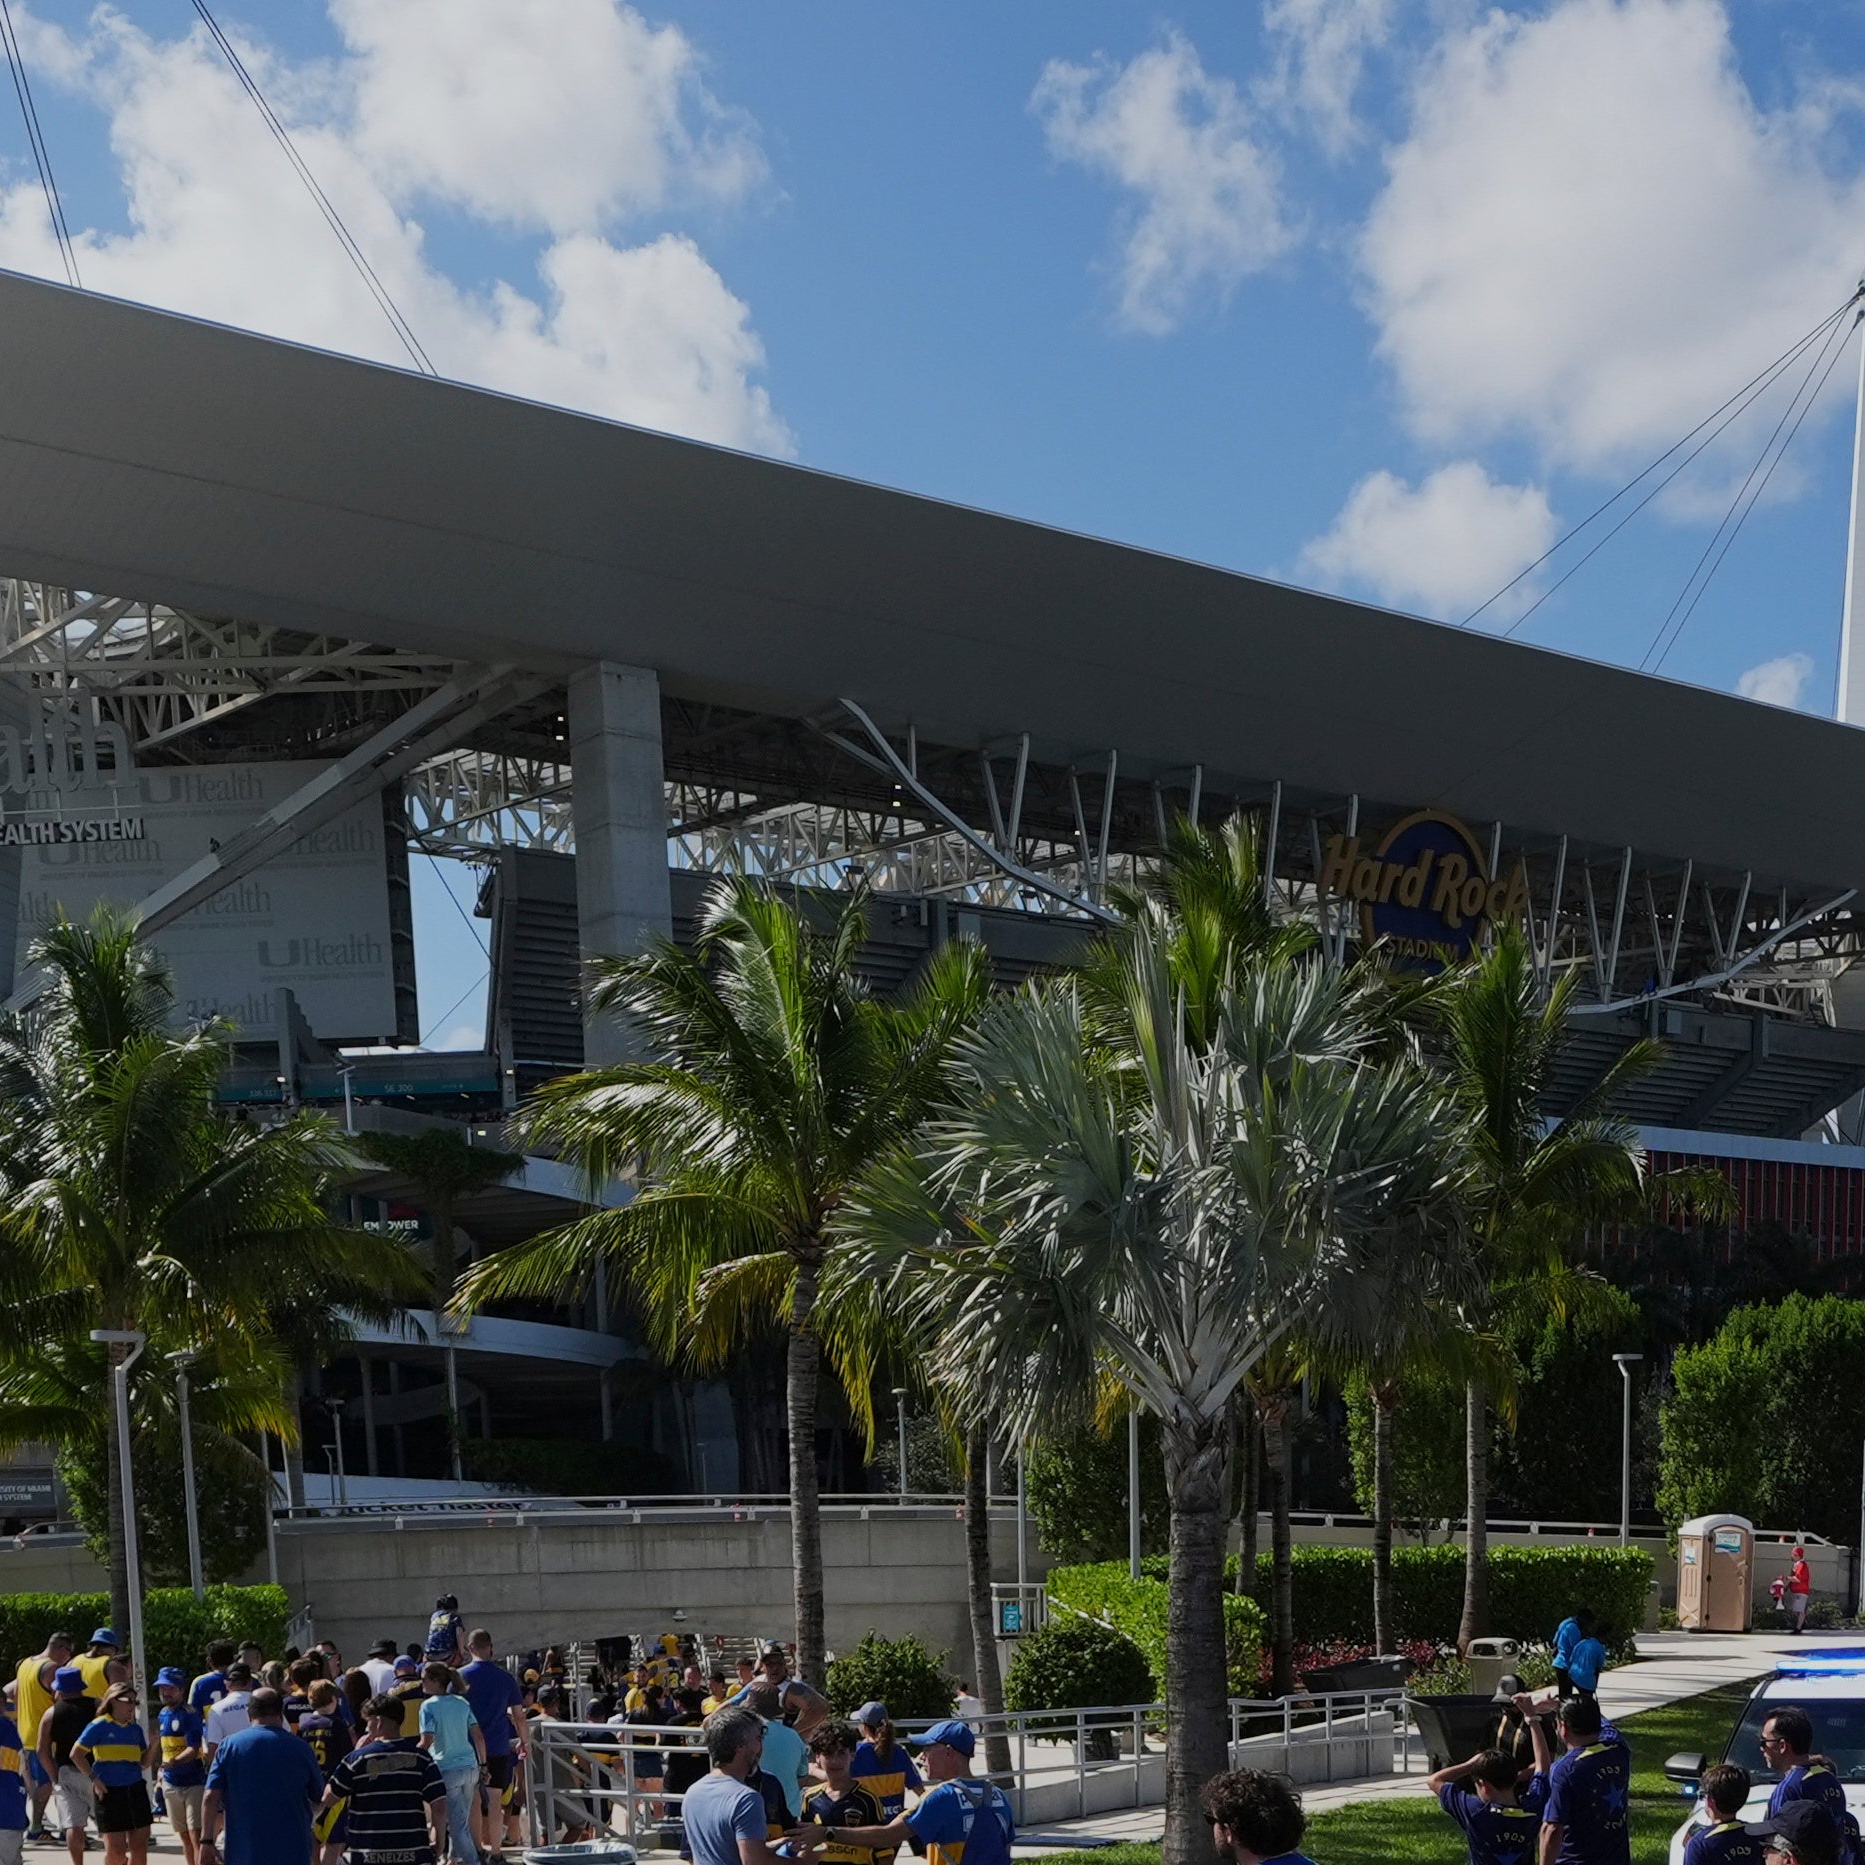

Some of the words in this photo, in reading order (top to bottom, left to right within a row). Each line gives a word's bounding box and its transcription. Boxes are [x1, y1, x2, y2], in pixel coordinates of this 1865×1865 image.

[58, 817, 144, 844] SYSTEM
[1319, 834, 1435, 908] Hard
[1429, 849, 1531, 930] Rock
[363, 1220, 419, 1234] EMOWER
[363, 1851, 416, 1864] XENEIZES
